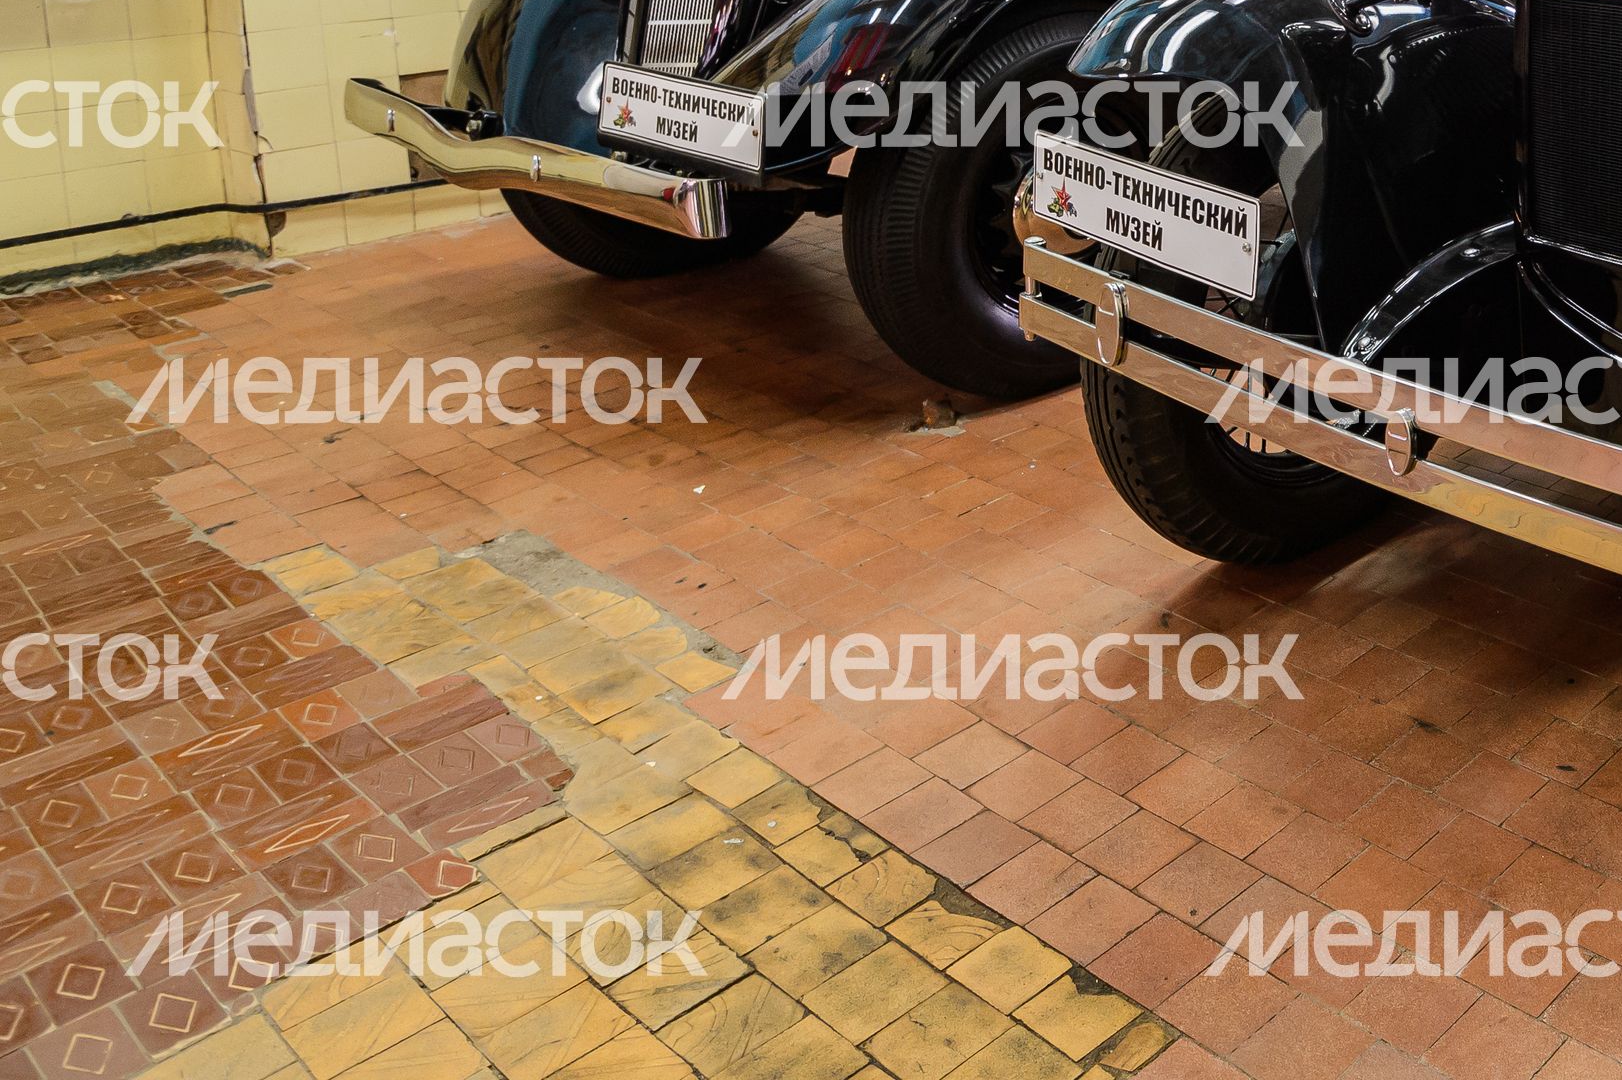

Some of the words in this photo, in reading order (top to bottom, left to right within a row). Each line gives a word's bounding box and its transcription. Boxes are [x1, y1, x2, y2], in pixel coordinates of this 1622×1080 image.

[612, 76, 756, 127] ВОЕННО-ТЕХНИЧЕСКИЙ
[656, 116, 698, 143] МУЗЕЙ
[1043, 148, 1249, 240] ВОЕННО-ТЕХНИЧЕСКИЙ
[1105, 206, 1164, 252] МУЗЕЙ
